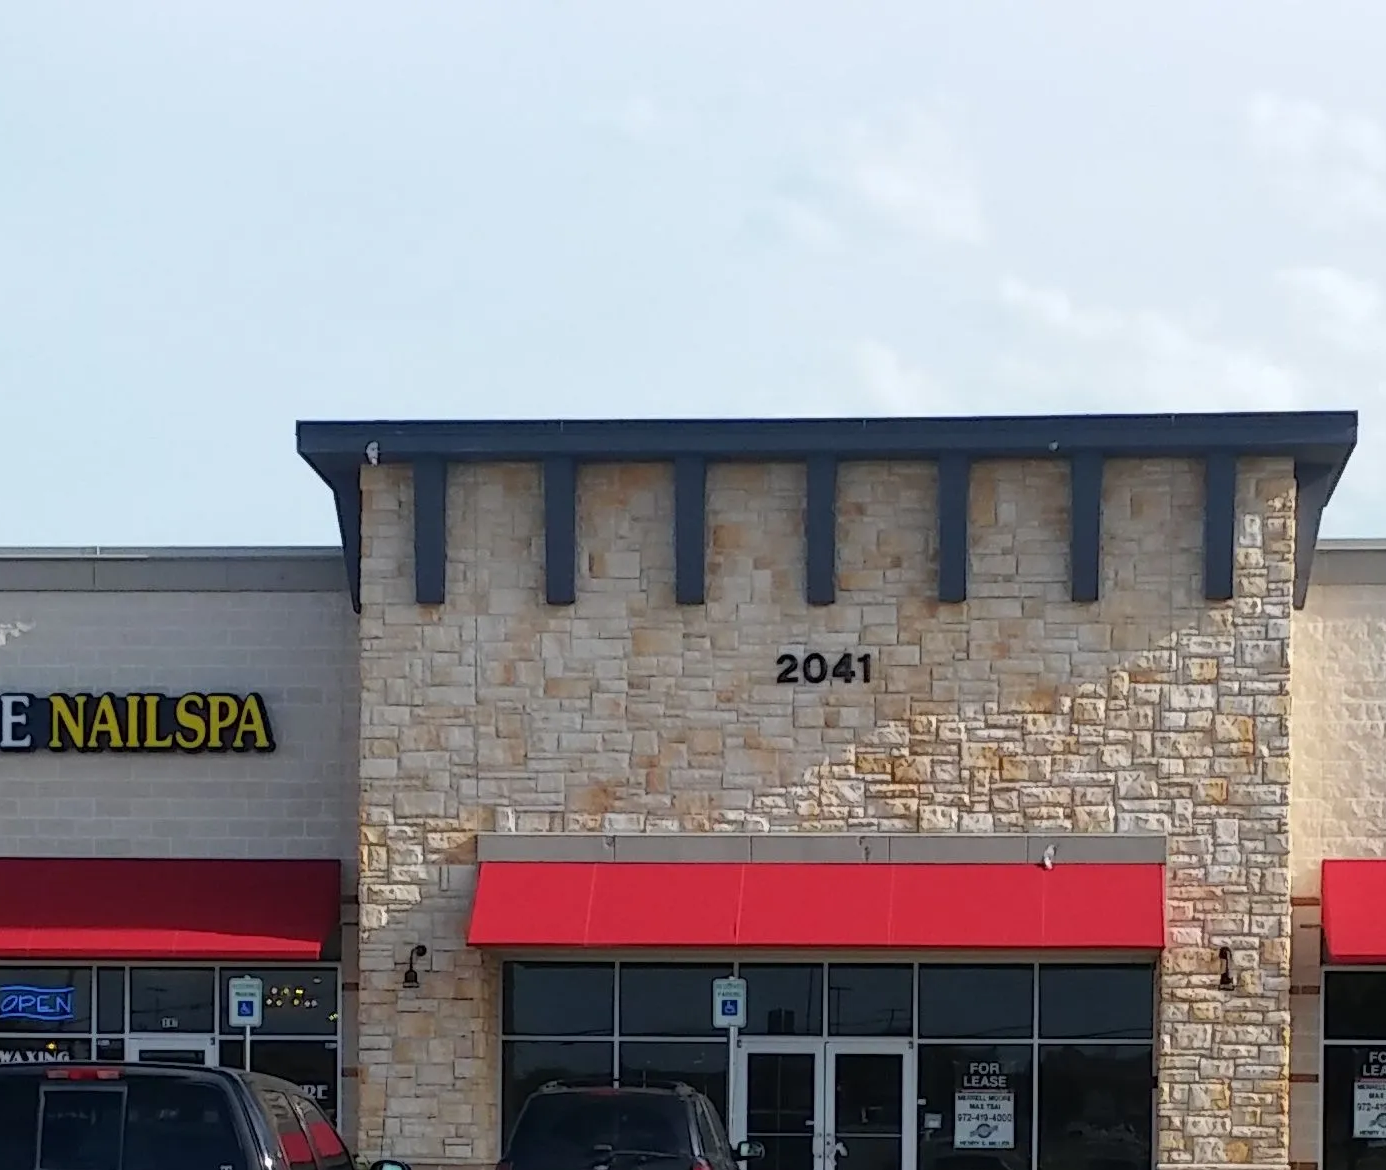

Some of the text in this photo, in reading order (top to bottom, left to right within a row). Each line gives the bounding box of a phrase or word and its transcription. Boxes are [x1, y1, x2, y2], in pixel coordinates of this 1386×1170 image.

[776, 652, 871, 684] 2041
[48, 693, 272, 750] NAILSPA
[0, 994, 72, 1013] OPEN
[969, 1062, 1000, 1075] FOR
[962, 1075, 1008, 1088] LEASE
